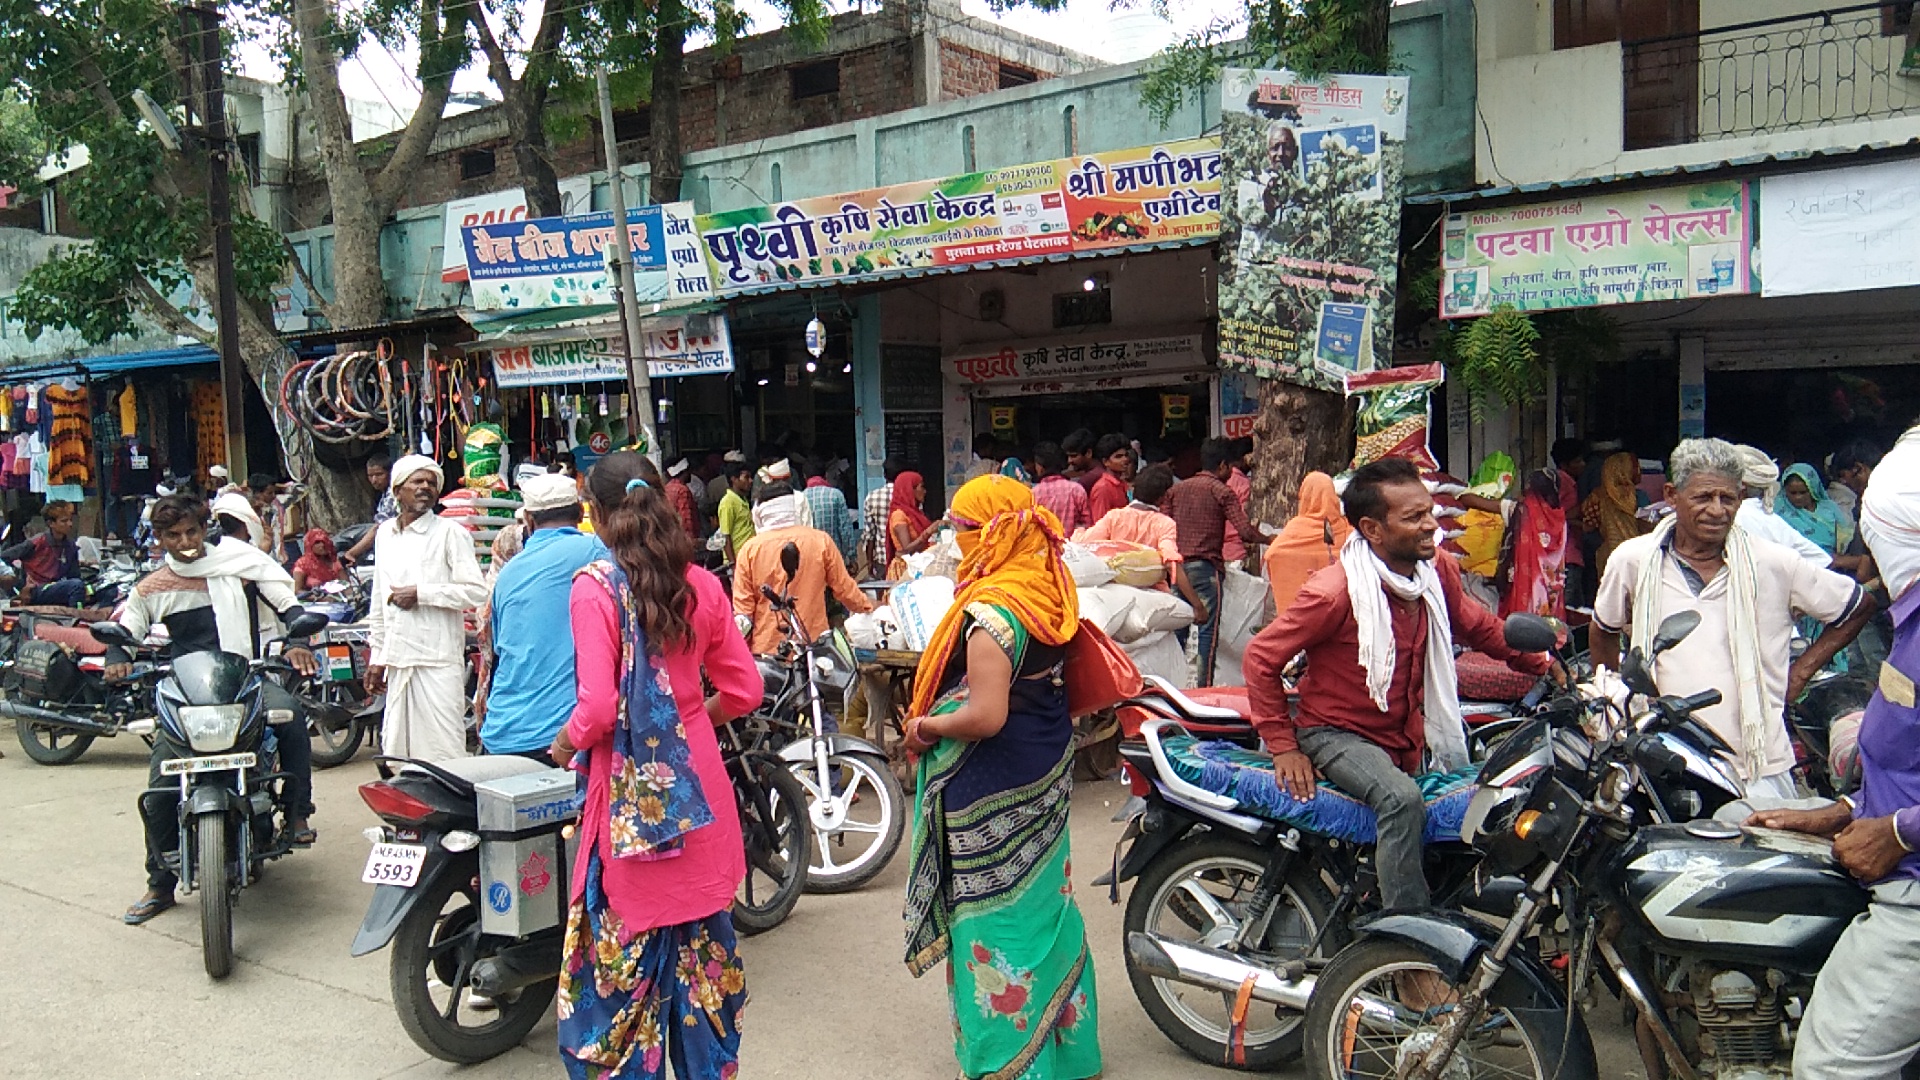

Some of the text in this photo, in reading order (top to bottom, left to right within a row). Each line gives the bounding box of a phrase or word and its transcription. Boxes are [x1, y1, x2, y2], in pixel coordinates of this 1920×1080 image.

[1069, 161, 1106, 196] श्री
[665, 212, 692, 235] जैन
[1476, 203, 1732, 261] पटवा एग्रो सेल्स
[473, 228, 515, 264] जैन
[514, 223, 570, 262] बीज
[703, 206, 823, 283] पृथ्वी
[820, 203, 870, 243] कृषि
[875, 199, 929, 230] सेवा
[934, 191, 997, 224] केन्द्र
[976, 243, 995, 255] बस
[671, 241, 700, 269] एग्रो
[674, 271, 709, 294] सेल्स
[1501, 271, 1520, 288] कृषि
[1579, 263, 1598, 280] कृषि
[1581, 282, 1600, 299] कृषि
[1023, 347, 1049, 373] कृषि
[1054, 343, 1085, 366] सेवा
[591, 435, 611, 449] 4G
[368, 862, 414, 882] 5593
